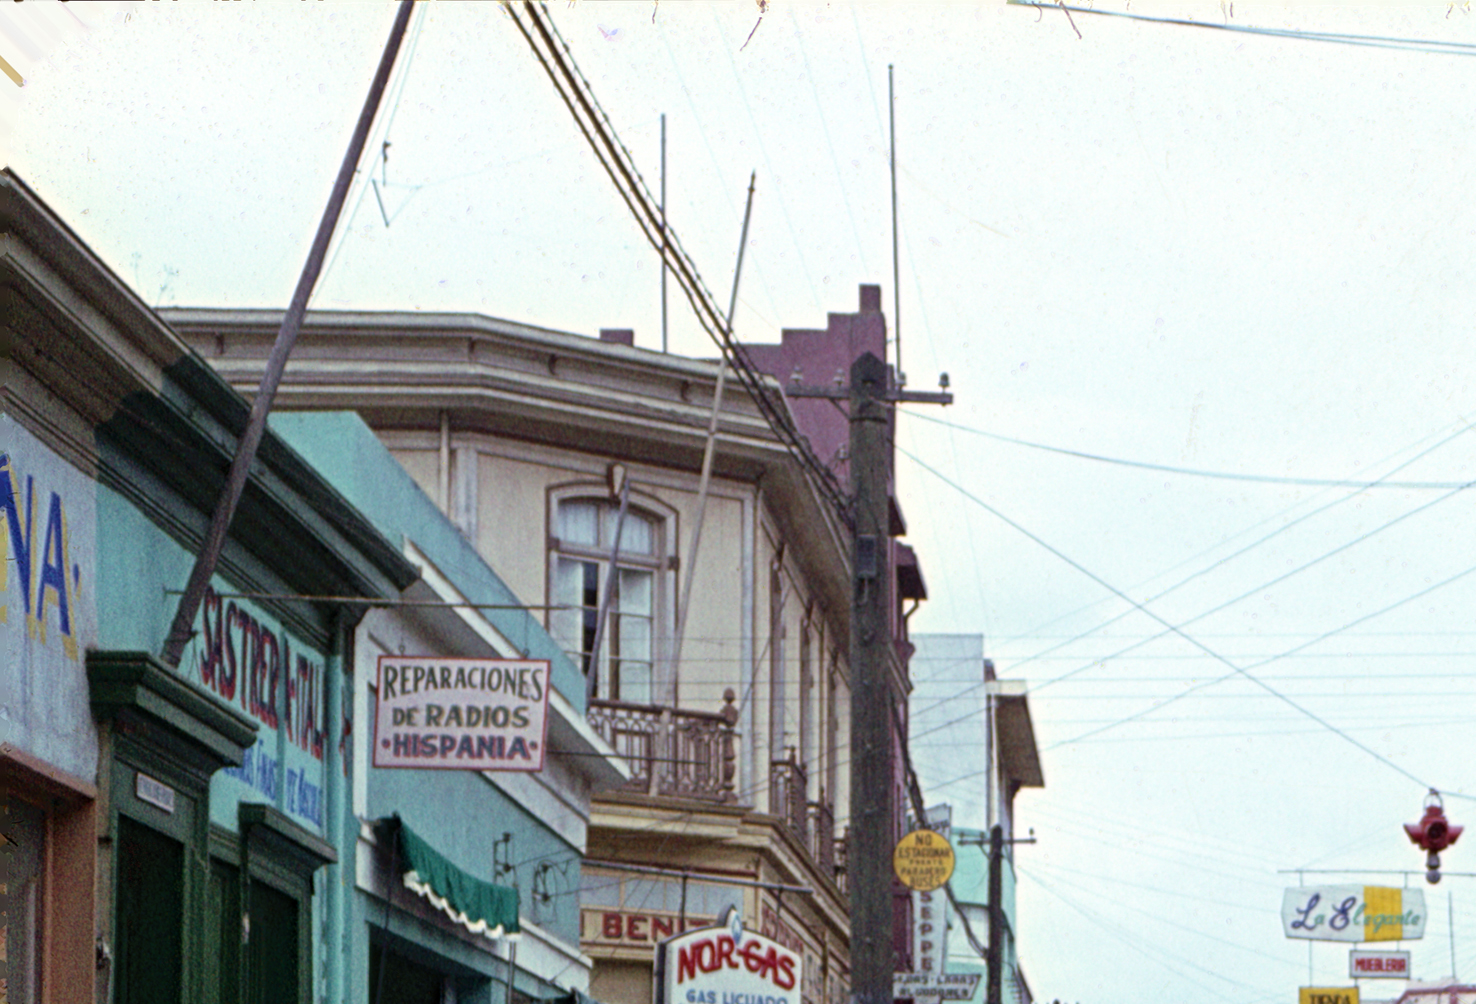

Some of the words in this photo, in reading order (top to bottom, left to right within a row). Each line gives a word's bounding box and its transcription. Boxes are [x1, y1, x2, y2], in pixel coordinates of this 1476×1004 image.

[383, 665, 543, 702] REPARACIONES
[392, 706, 418, 727] DE
[425, 703, 530, 729] RADIOS
[914, 833, 933, 846] NO
[1291, 892, 1326, 931] La
[1329, 896, 1422, 934] Elegante
[676, 934, 797, 991] NOR-GAS
[686, 986, 718, 1004] GAS
